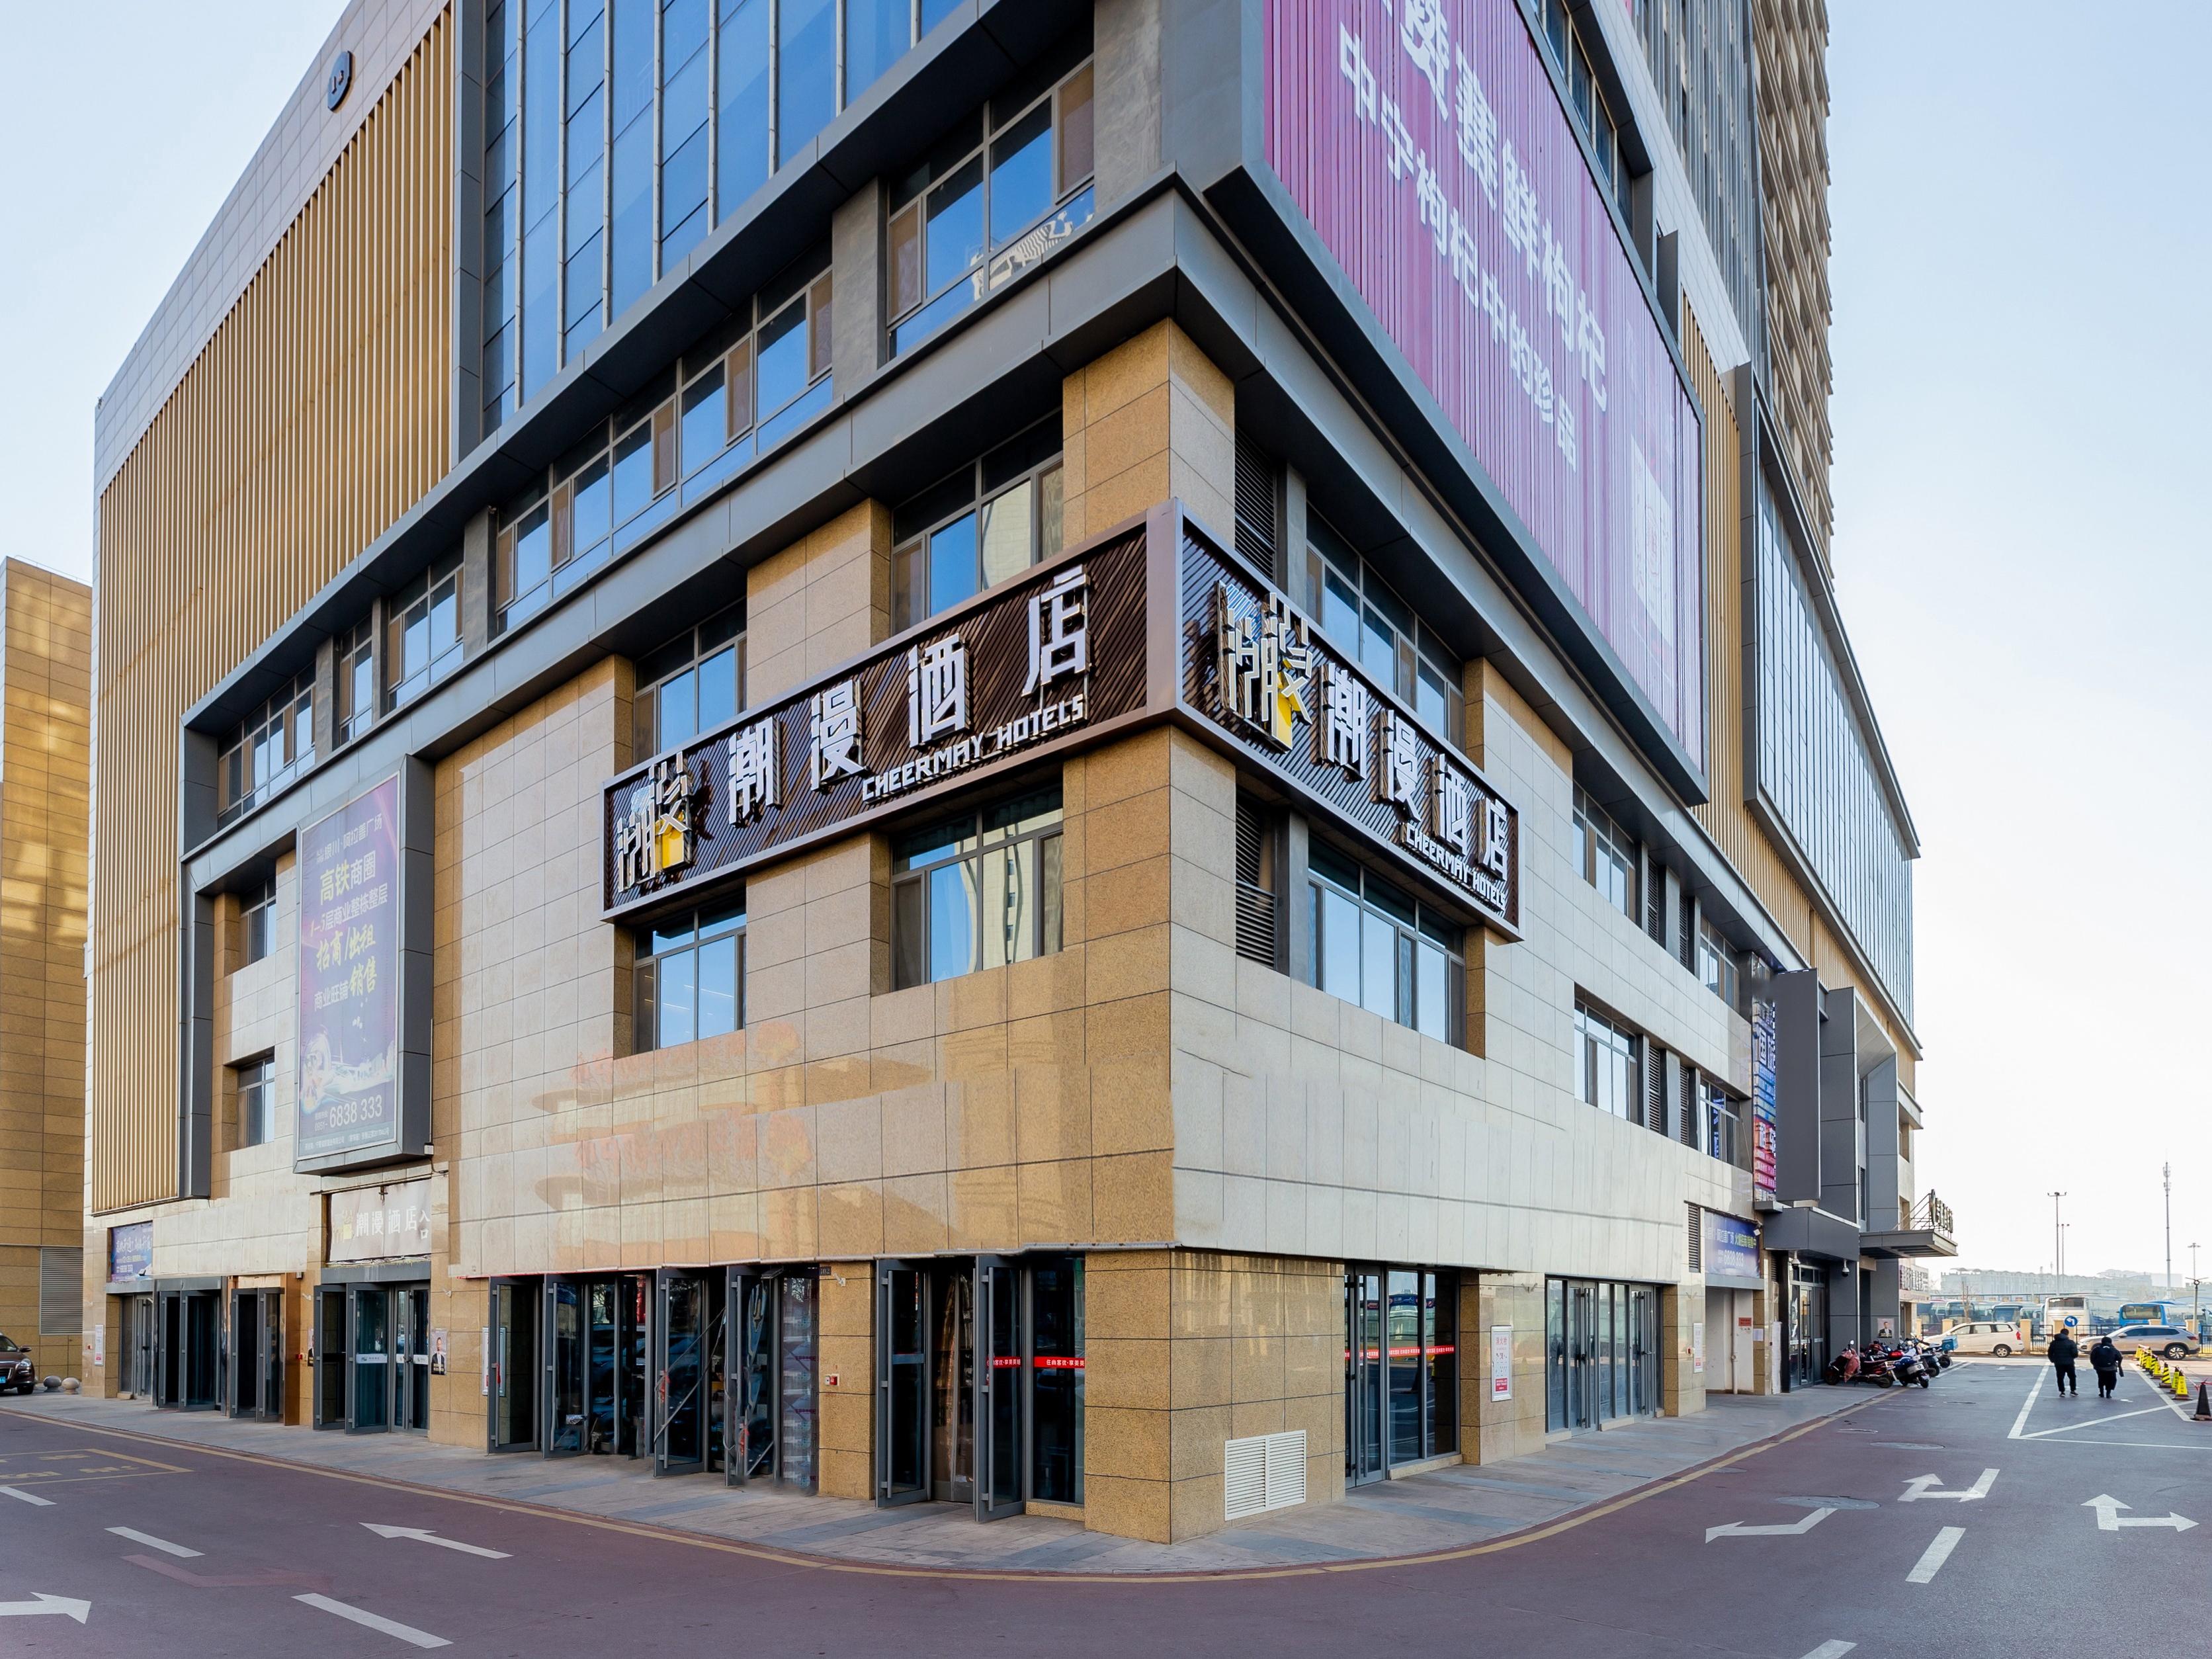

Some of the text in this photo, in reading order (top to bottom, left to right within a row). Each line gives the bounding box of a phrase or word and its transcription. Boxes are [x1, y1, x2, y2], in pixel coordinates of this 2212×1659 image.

[1340, 22, 1577, 472] 中宁枸杞中的珍品
[729, 565, 1091, 826] 潮漫酒店
[862, 693, 1084, 802] CHEERMAY HOTELS
[1327, 662, 1508, 882] 潮漫酒店
[320, 850, 376, 905] 高铁商圈
[1406, 822, 1506, 912] CHEERMAY HOTELS
[360, 1094, 382, 1121] 333
[357, 1206, 417, 1237] 潮漫酒店
[419, 1210, 430, 1240] 入口
